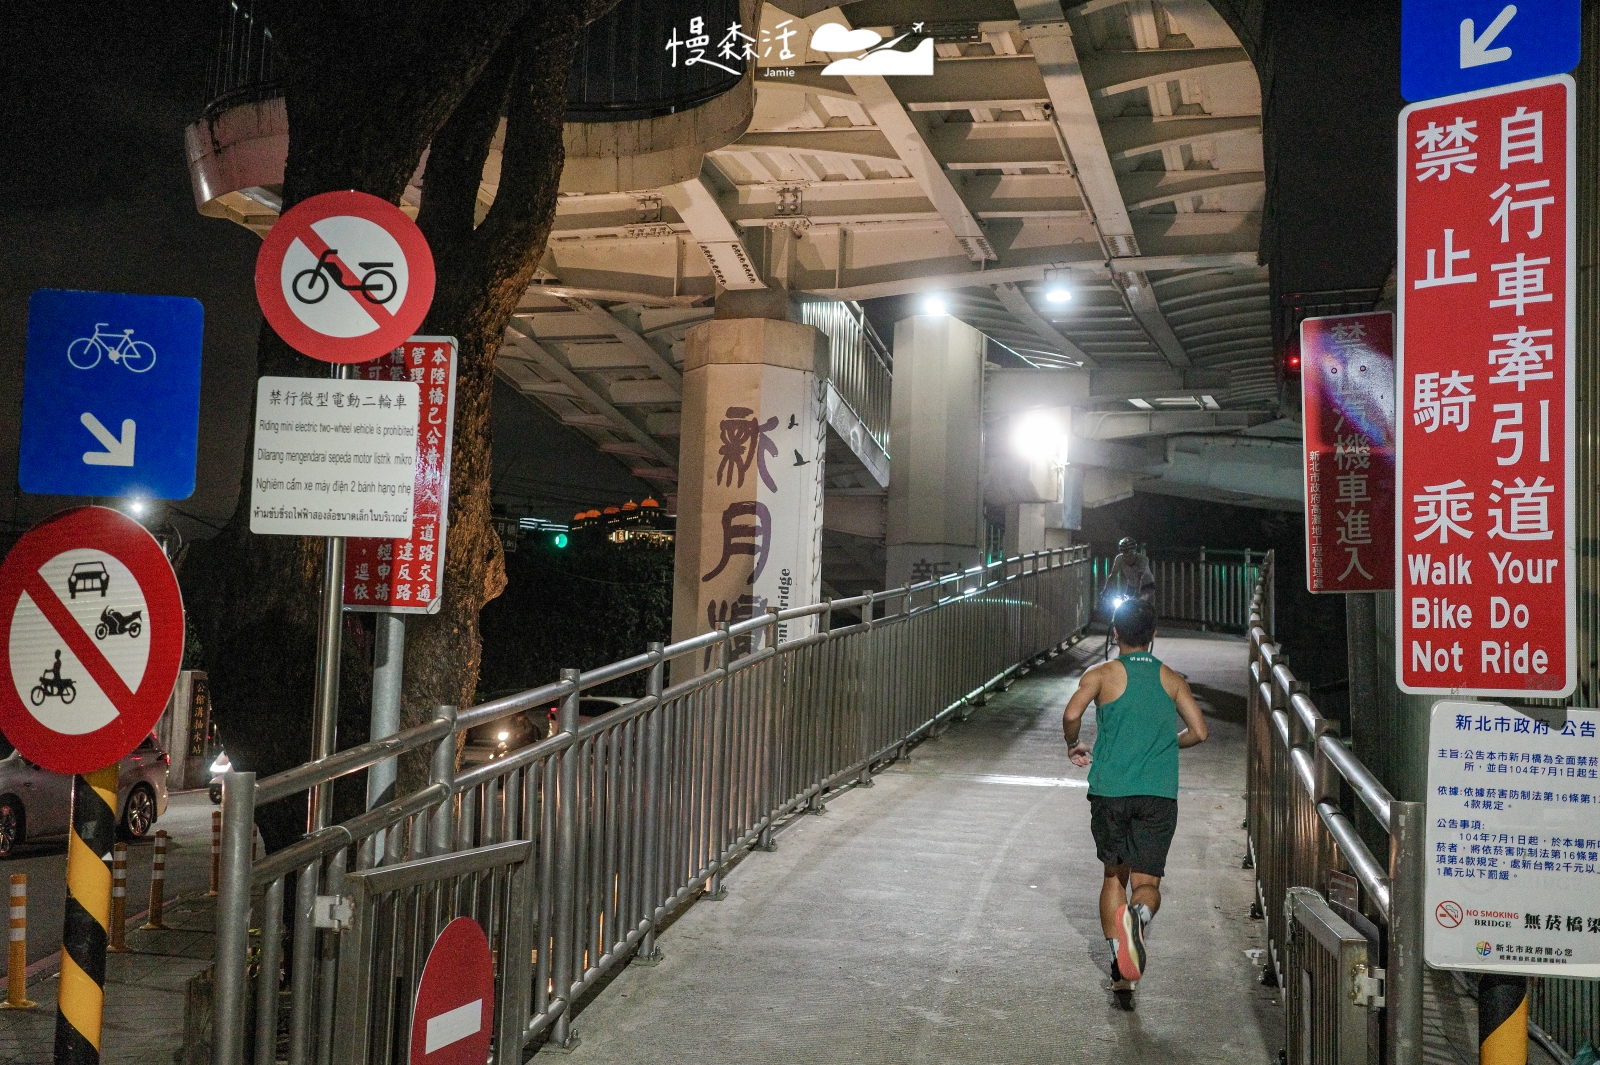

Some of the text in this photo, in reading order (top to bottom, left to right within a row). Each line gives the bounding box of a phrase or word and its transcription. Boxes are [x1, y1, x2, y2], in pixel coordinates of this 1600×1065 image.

[1413, 117, 1479, 544] 禁止騎乘
[1487, 106, 1555, 541] 自行車牽引道
[269, 389, 407, 410] 禁行微型電動二輪車
[259, 420, 414, 438] Riding mini electric two-wheel vehicle is prohibited
[257, 448, 412, 466] Dilarang mengendarai sepeda motor listrik mikro
[1330, 321, 1374, 582] 禁汽機車進入
[256, 477, 411, 496] Nghiêm cấm xe máy điện 2 bánh hạng nhẹ
[1408, 551, 1559, 586] Walk Your
[778, 568, 793, 612] ridge
[1411, 596, 1530, 629] Bike Do
[1412, 640, 1549, 675] Not Ride
[1455, 714, 1597, 738] 新北市政府 公告
[1437, 786, 1600, 805] 依據:依據菸害防制法第16條第1
[1436, 854, 1600, 874] 項第4款規定，處新台幣2千元以
[1466, 909, 1519, 920] NO SMOKING
[1474, 918, 1512, 928] BRIDGE
